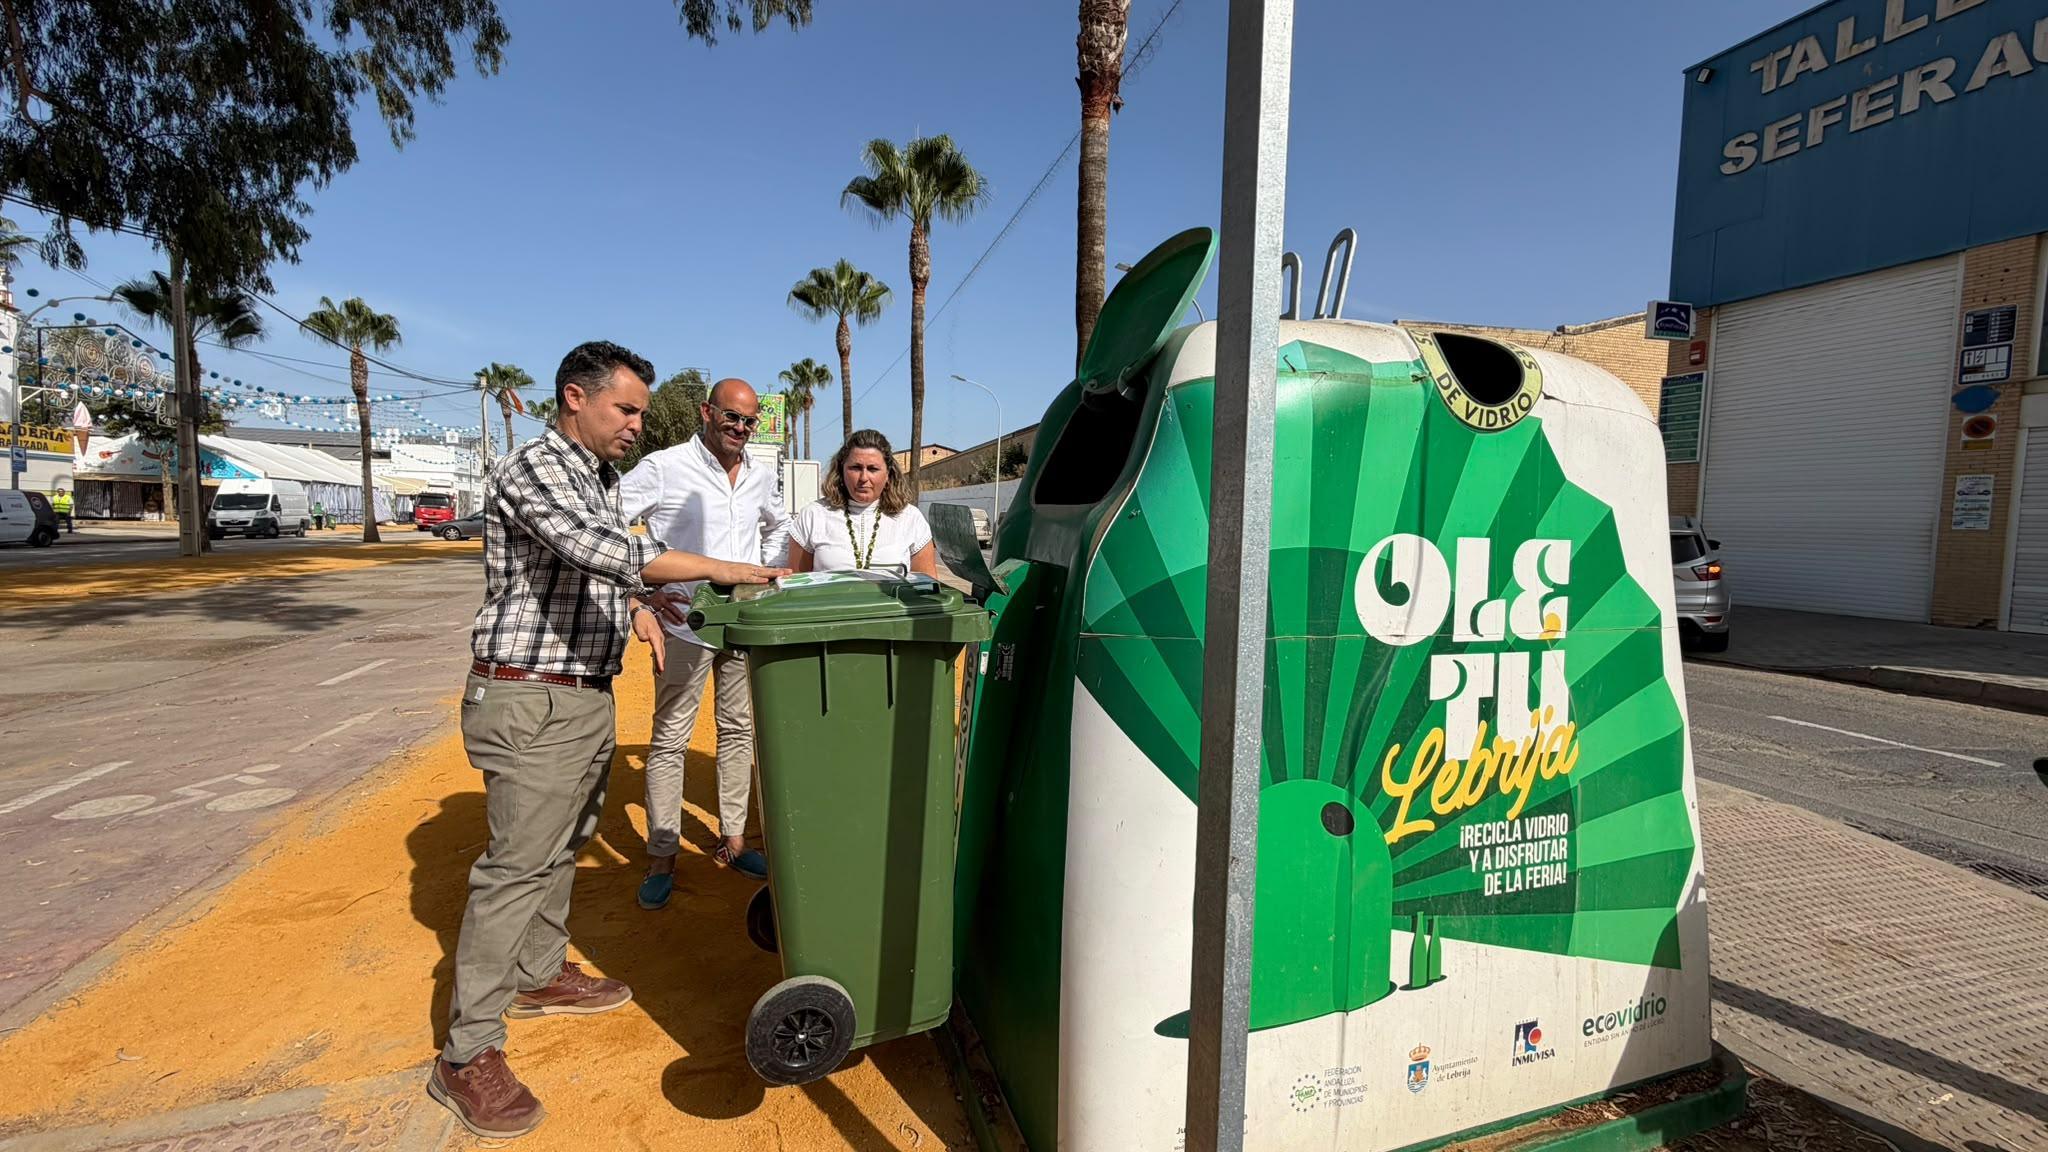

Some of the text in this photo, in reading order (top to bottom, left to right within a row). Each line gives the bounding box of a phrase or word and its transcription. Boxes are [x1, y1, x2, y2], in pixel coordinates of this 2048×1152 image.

[1436, 372, 1532, 427] DE VIDRIO
[0, 437, 49, 451] RAIZADA
[1354, 533, 1572, 646] OLE
[1429, 650, 1570, 762] TU
[1382, 705, 1579, 844] Lebrija
[1460, 813, 1569, 849] ¡RECICLA VIDRIO
[1469, 838, 1568, 873] Y A DISFRUTAR
[1484, 862, 1567, 896] DE LA FERIA!
[1583, 992, 1667, 1037] ecovidrio
[1432, 1056, 1478, 1072] Ayuntamiento
[1446, 1069, 1471, 1080] Lebrija
[1512, 1048, 1555, 1067] INMUVISA
